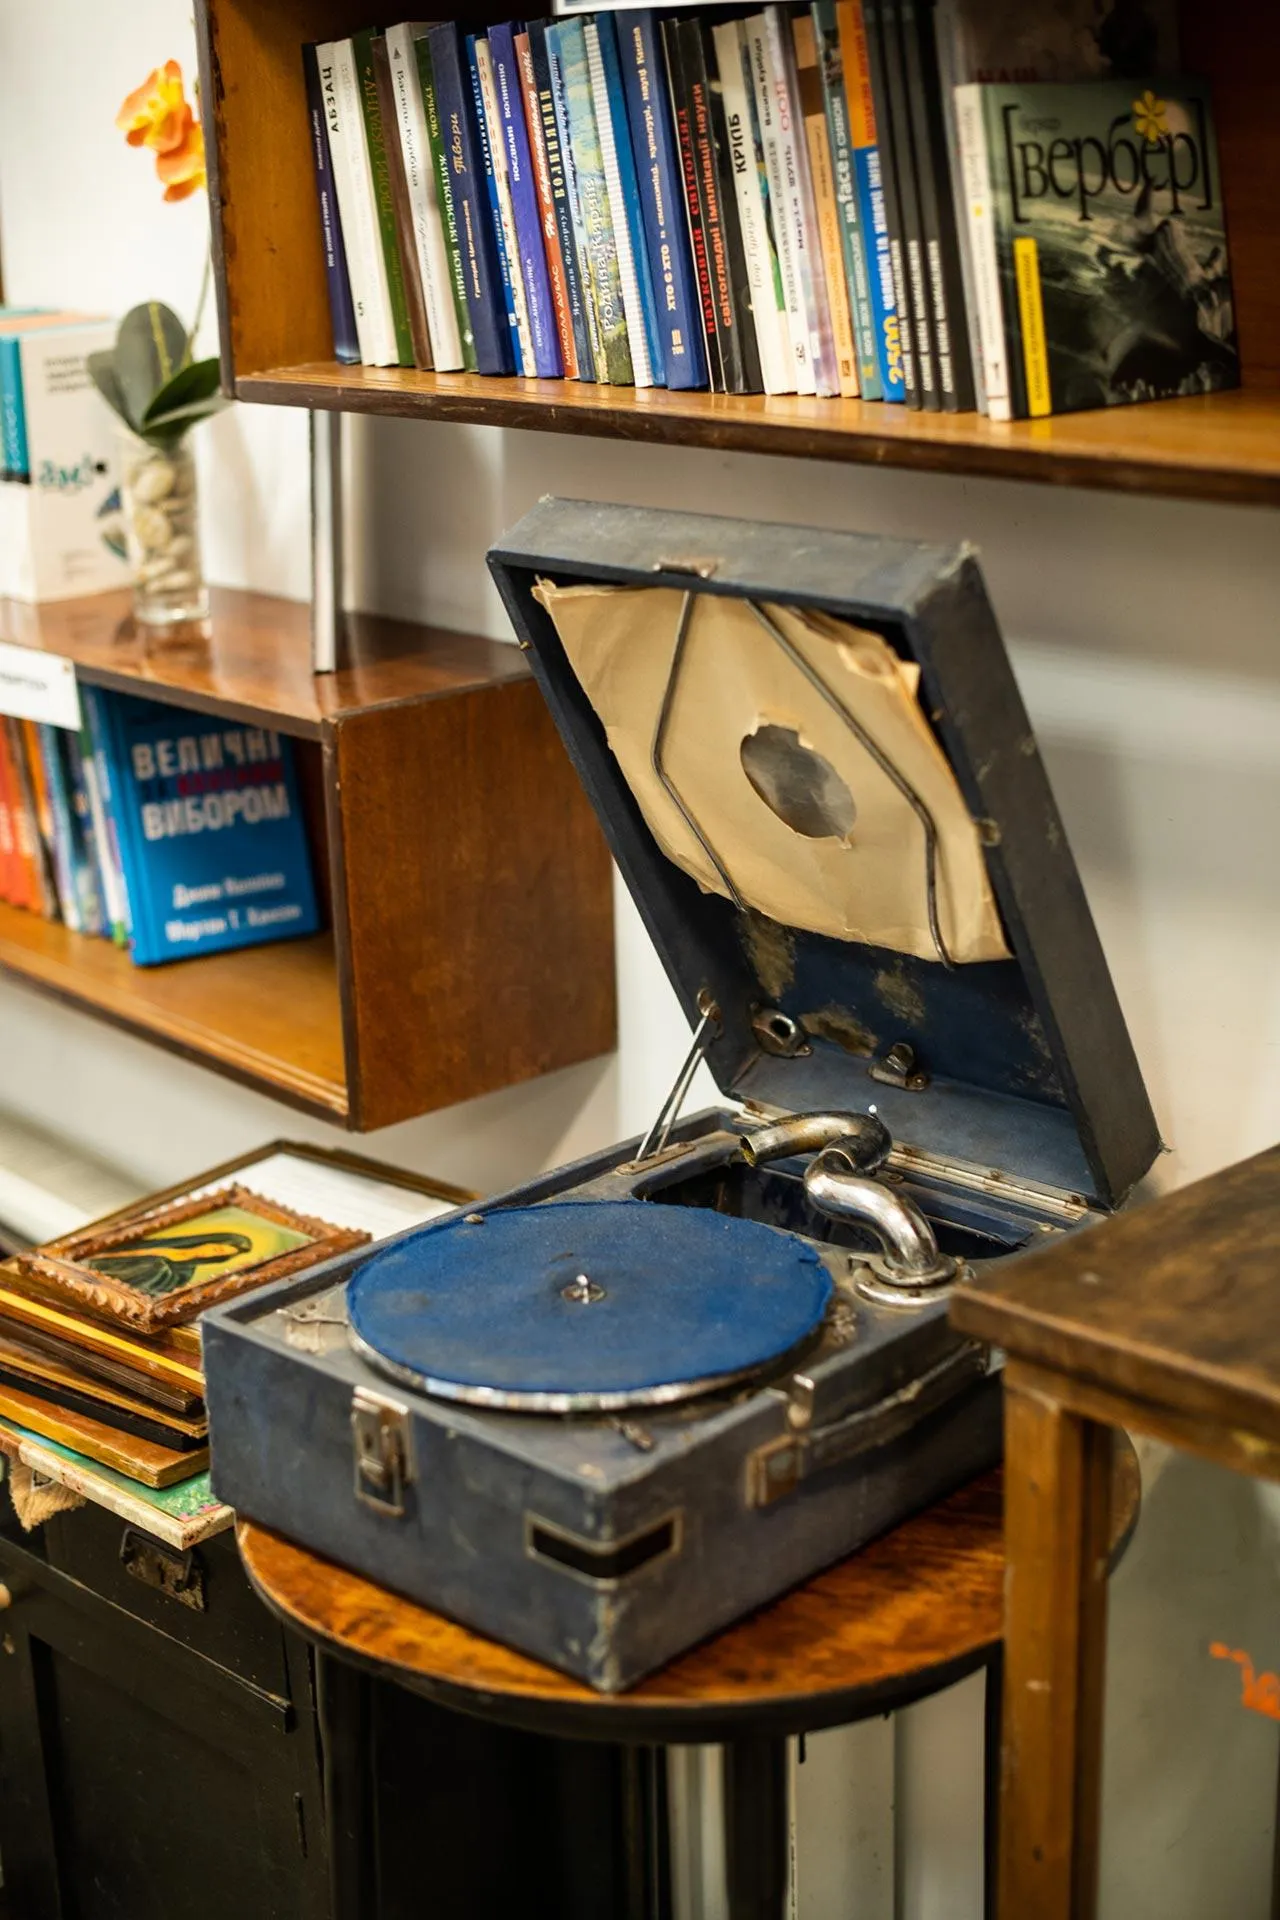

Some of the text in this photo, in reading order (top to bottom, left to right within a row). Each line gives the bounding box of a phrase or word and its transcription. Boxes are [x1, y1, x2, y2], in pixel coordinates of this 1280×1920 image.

[322, 66, 341, 134] АБЗАЦ
[521, 50, 534, 85] коні
[753, 37, 773, 127] Василь Куйбіда
[424, 85, 440, 137] ТУЧКОВА
[447, 111, 468, 176] Твори
[497, 63, 521, 182] ПОЄДНАНІ ВОЛИННЮ
[363, 78, 394, 216] ТВОРИ УКРАЇНУ
[436, 152, 468, 300] ЖИТКОВСЬКІ БОГИНІ
[543, 211, 556, 240] На
[691, 83, 733, 328] світоглядні імплікації науки
[558, 207, 582, 317] Ярослав Федорчук
[581, 176, 617, 332] Родина Кирчів
[659, 244, 672, 272] ХТО
[551, 264, 573, 367] МИКОЛА ДУБАС
[664, 283, 677, 312] ХТО
[881, 314, 904, 385] 2500
[132, 729, 281, 781] ВЕЛИЧНІ
[142, 783, 291, 841] ВИБОРОМ
